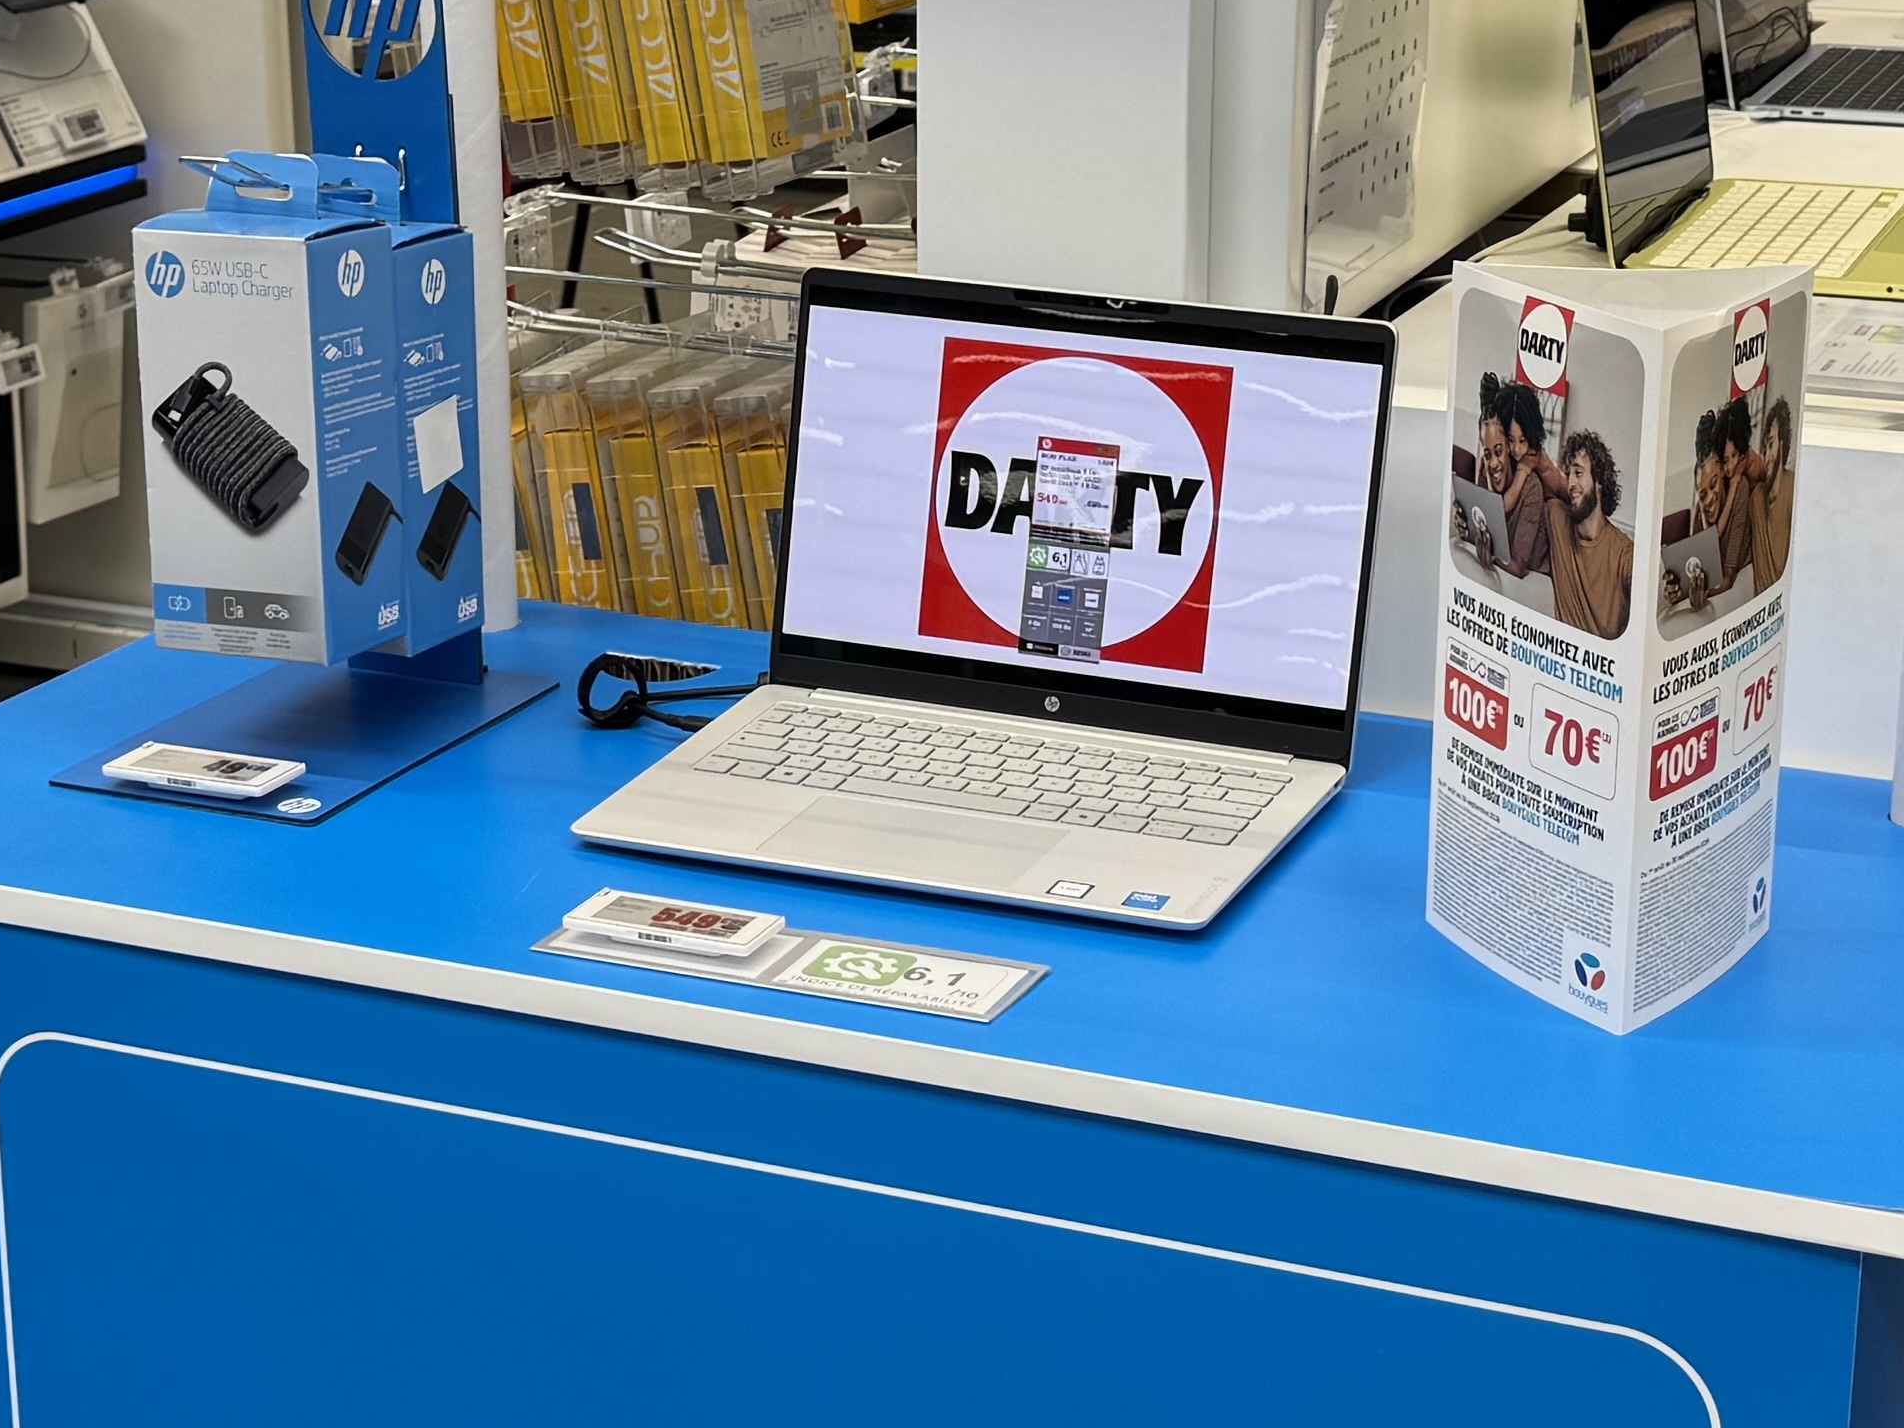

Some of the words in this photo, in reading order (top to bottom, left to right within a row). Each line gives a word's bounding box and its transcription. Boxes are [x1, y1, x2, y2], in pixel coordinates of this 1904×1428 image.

[146, 250, 186, 299] hp
[191, 258, 222, 278] 65W
[225, 261, 268, 281] USB-C
[192, 278, 240, 299] Laptop
[241, 280, 295, 300] Charger
[339, 249, 363, 298] hp
[422, 258, 445, 305] hp
[1518, 325, 1568, 368] DARTY
[1733, 324, 1768, 368] DARTY
[944, 450, 1205, 556] DATY
[379, 603, 400, 625] USB
[458, 596, 479, 618] USB
[1446, 606, 1462, 629] LES
[1461, 614, 1495, 647] OFFRES
[1495, 637, 1510, 656] DE
[1510, 643, 1566, 688] BOUYGUES
[1569, 667, 1624, 704] TELECOM
[1453, 586, 1477, 615] VOUS
[1477, 601, 1508, 633] AUSSI,
[1510, 616, 1579, 664] ÉCONOMISEZ
[1581, 650, 1616, 678] AVEC
[1661, 648, 1690, 678] VOUS
[1689, 636, 1720, 667] AUSSI,
[1720, 608, 1767, 651] ÉCONOMISEZ
[1766, 592, 1784, 621] AVEC
[1652, 679, 1672, 705] LES
[1671, 663, 1709, 695] OFFRES
[1708, 657, 1721, 677] DE
[1720, 633, 1761, 672] BOUYGUES
[1759, 610, 1786, 648] TELECOM
[1513, 713, 1525, 729] OU
[1446, 749, 1456, 766] DE
[1454, 754, 1468, 772] VOS
[1467, 759, 1497, 789] ACHATS
[1495, 778, 1516, 801] POUR
[1516, 790, 1542, 815] TOUTE
[1542, 803, 1605, 842] SOUSCRIPTION
[1451, 736, 1462, 755] DE
[1460, 738, 1484, 768] REMISE
[1484, 756, 1525, 789] IMMÉDIATE
[1526, 778, 1543, 798] SUR
[1544, 787, 1555, 803] LE
[1554, 791, 1600, 824] MONTANT
[1467, 775, 1482, 797] UNE
[1500, 796, 1542, 830] BOUYGUES
[1542, 813, 1581, 846] TELECOM
[791, 974, 845, 988] INDICE
[848, 984, 868, 993] DE
[869, 987, 979, 1010] RÉPARABILITÉ
